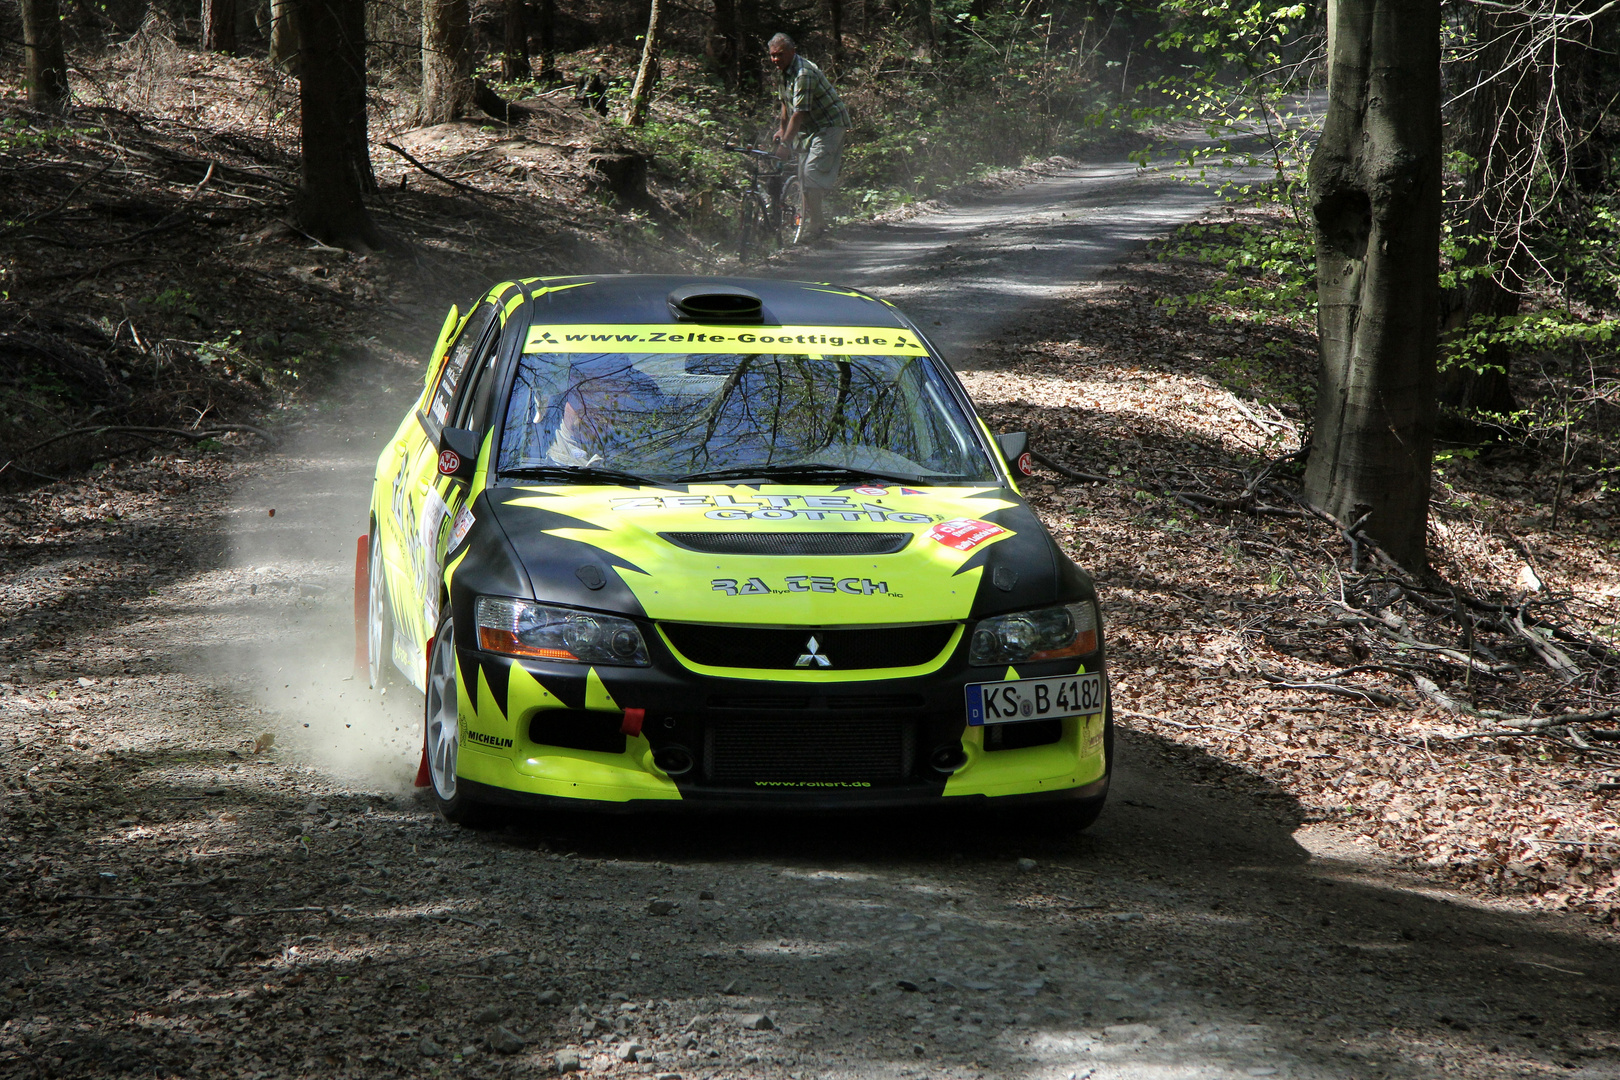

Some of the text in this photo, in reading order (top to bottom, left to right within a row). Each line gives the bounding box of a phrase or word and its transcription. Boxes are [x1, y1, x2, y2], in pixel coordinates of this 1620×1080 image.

[565, 331, 888, 347] www.Zelte-Goettig.de
[609, 494, 858, 511] ZELTE
[703, 506, 934, 523] GÖTTIG
[983, 678, 1100, 719] KS B 4182
[972, 708, 979, 718] D
[468, 730, 513, 748] MICHELIN
